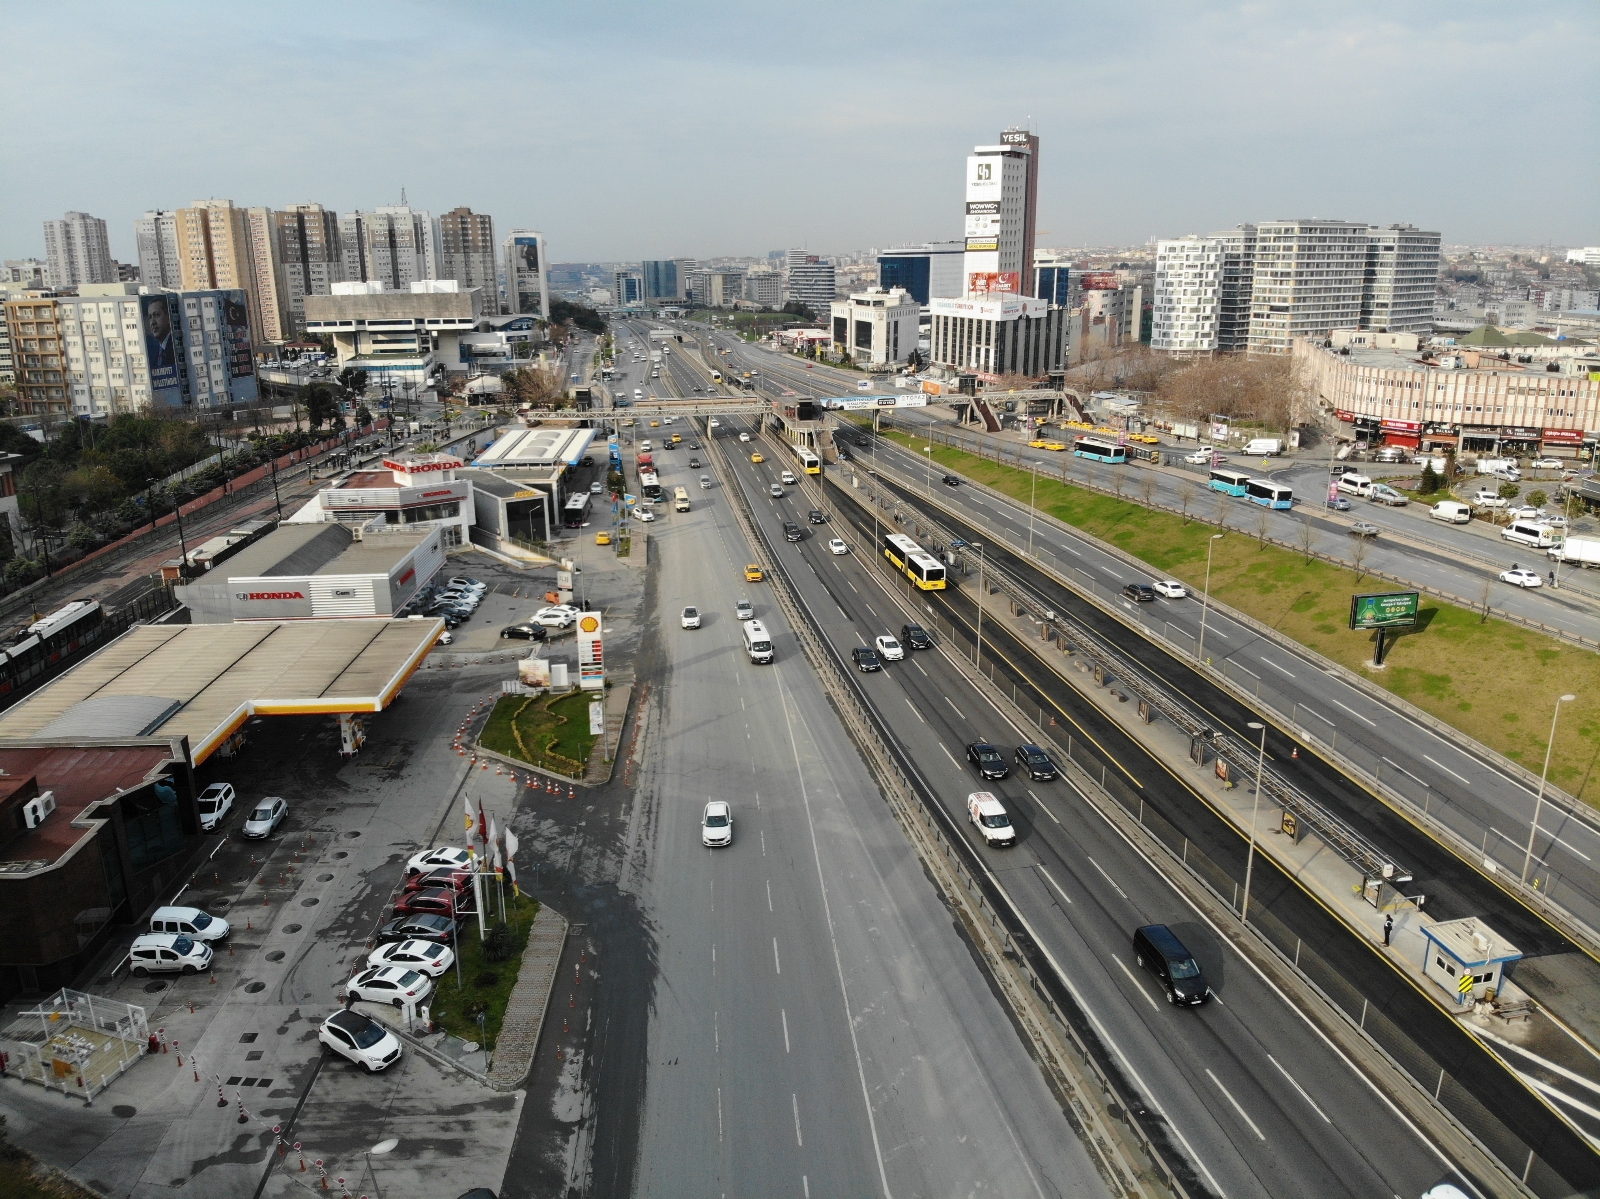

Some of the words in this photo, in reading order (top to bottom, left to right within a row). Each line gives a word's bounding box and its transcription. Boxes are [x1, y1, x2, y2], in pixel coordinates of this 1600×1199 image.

[410, 461, 463, 473] HONDA
[422, 489, 452, 498] HONDA
[248, 591, 304, 600] HONDA
